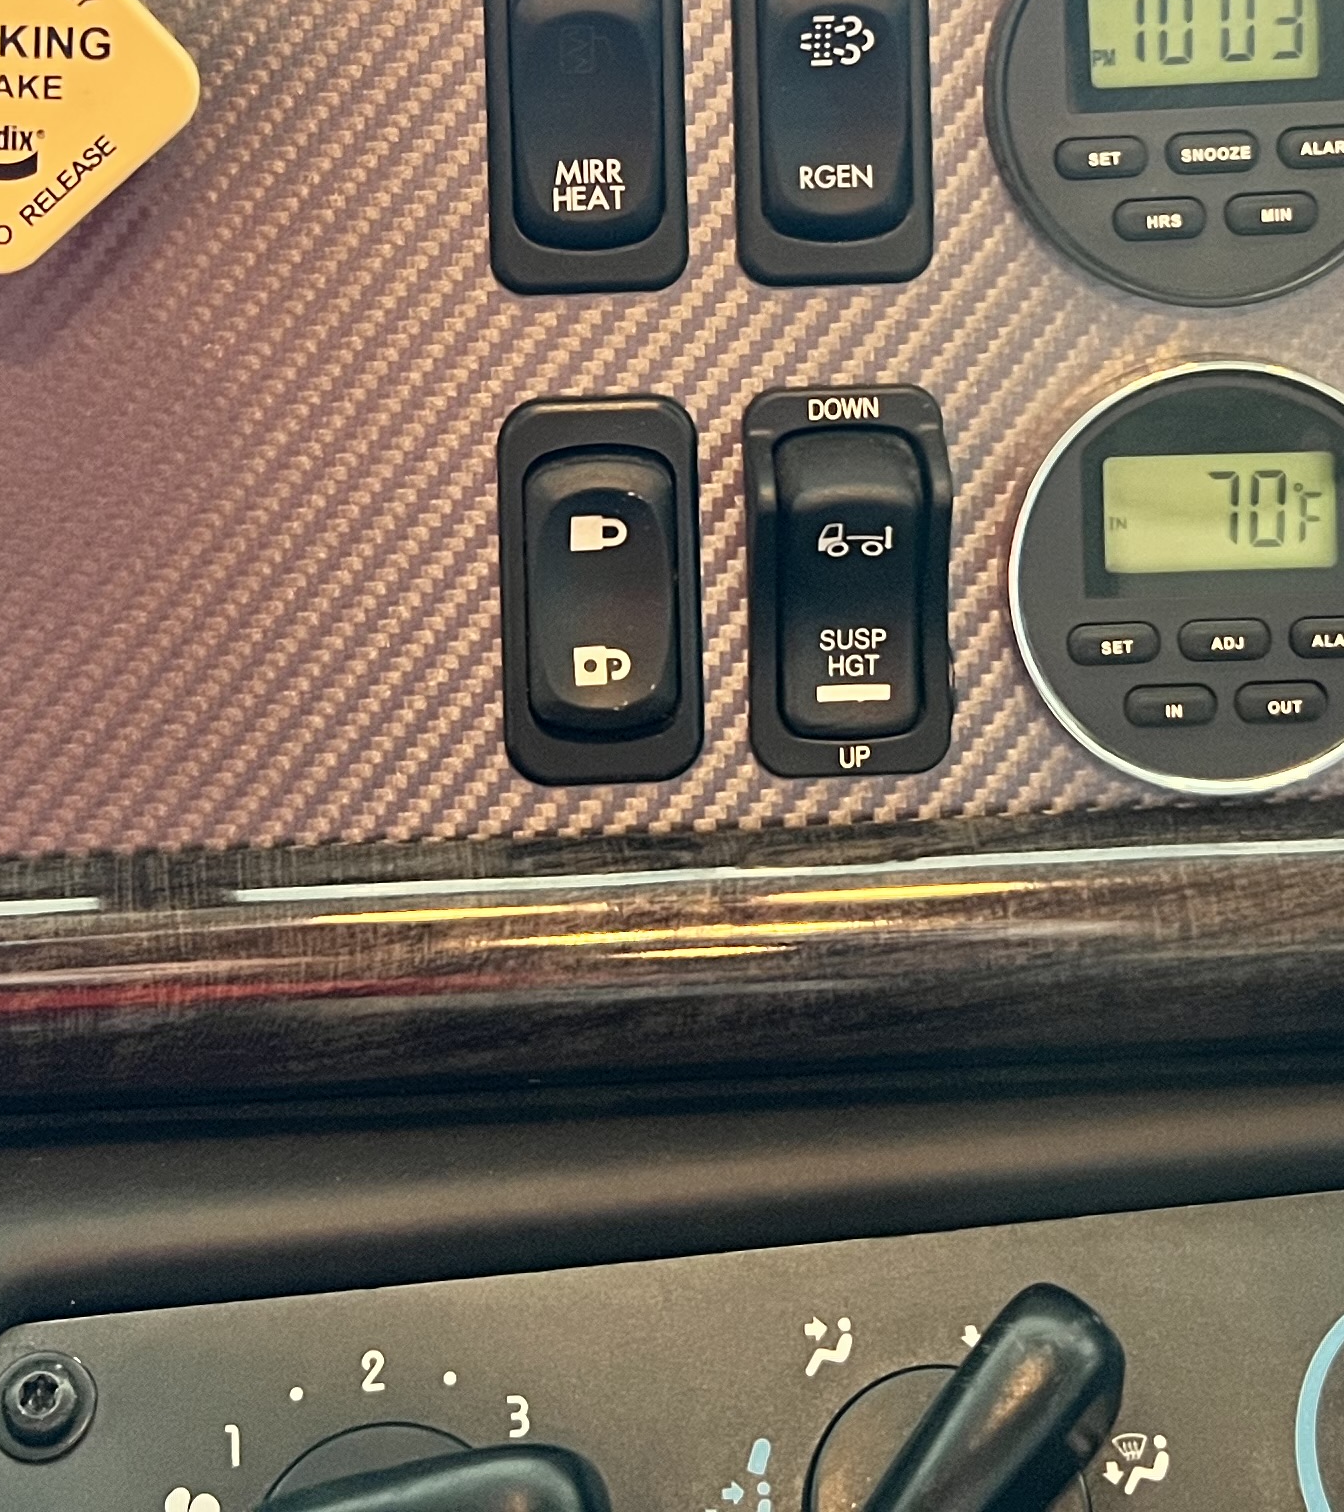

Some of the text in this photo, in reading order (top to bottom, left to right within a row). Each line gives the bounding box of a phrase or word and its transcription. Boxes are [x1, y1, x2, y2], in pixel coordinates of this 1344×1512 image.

[1088, 151, 1122, 168] SET
[1180, 145, 1252, 164] SNOOZE
[19, 134, 117, 227] RELEASE
[554, 158, 624, 185] MIRR
[798, 163, 874, 190] RGEN
[552, 185, 626, 212] HEAT
[1145, 213, 1183, 230] HRS
[1260, 207, 1293, 224] MIN
[807, 397, 880, 421] DOWN
[1109, 516, 1128, 531] IN
[818, 628, 888, 652] SUSP
[1100, 639, 1134, 656] SET
[1210, 635, 1245, 651] ADJ
[827, 653, 881, 676] HGT
[1165, 704, 1183, 719] IN
[1267, 699, 1303, 715] OUT
[838, 744, 872, 769] UP
[360, 1349, 386, 1392] 2
[505, 1395, 531, 1438] 3
[224, 1424, 241, 1468] 1
